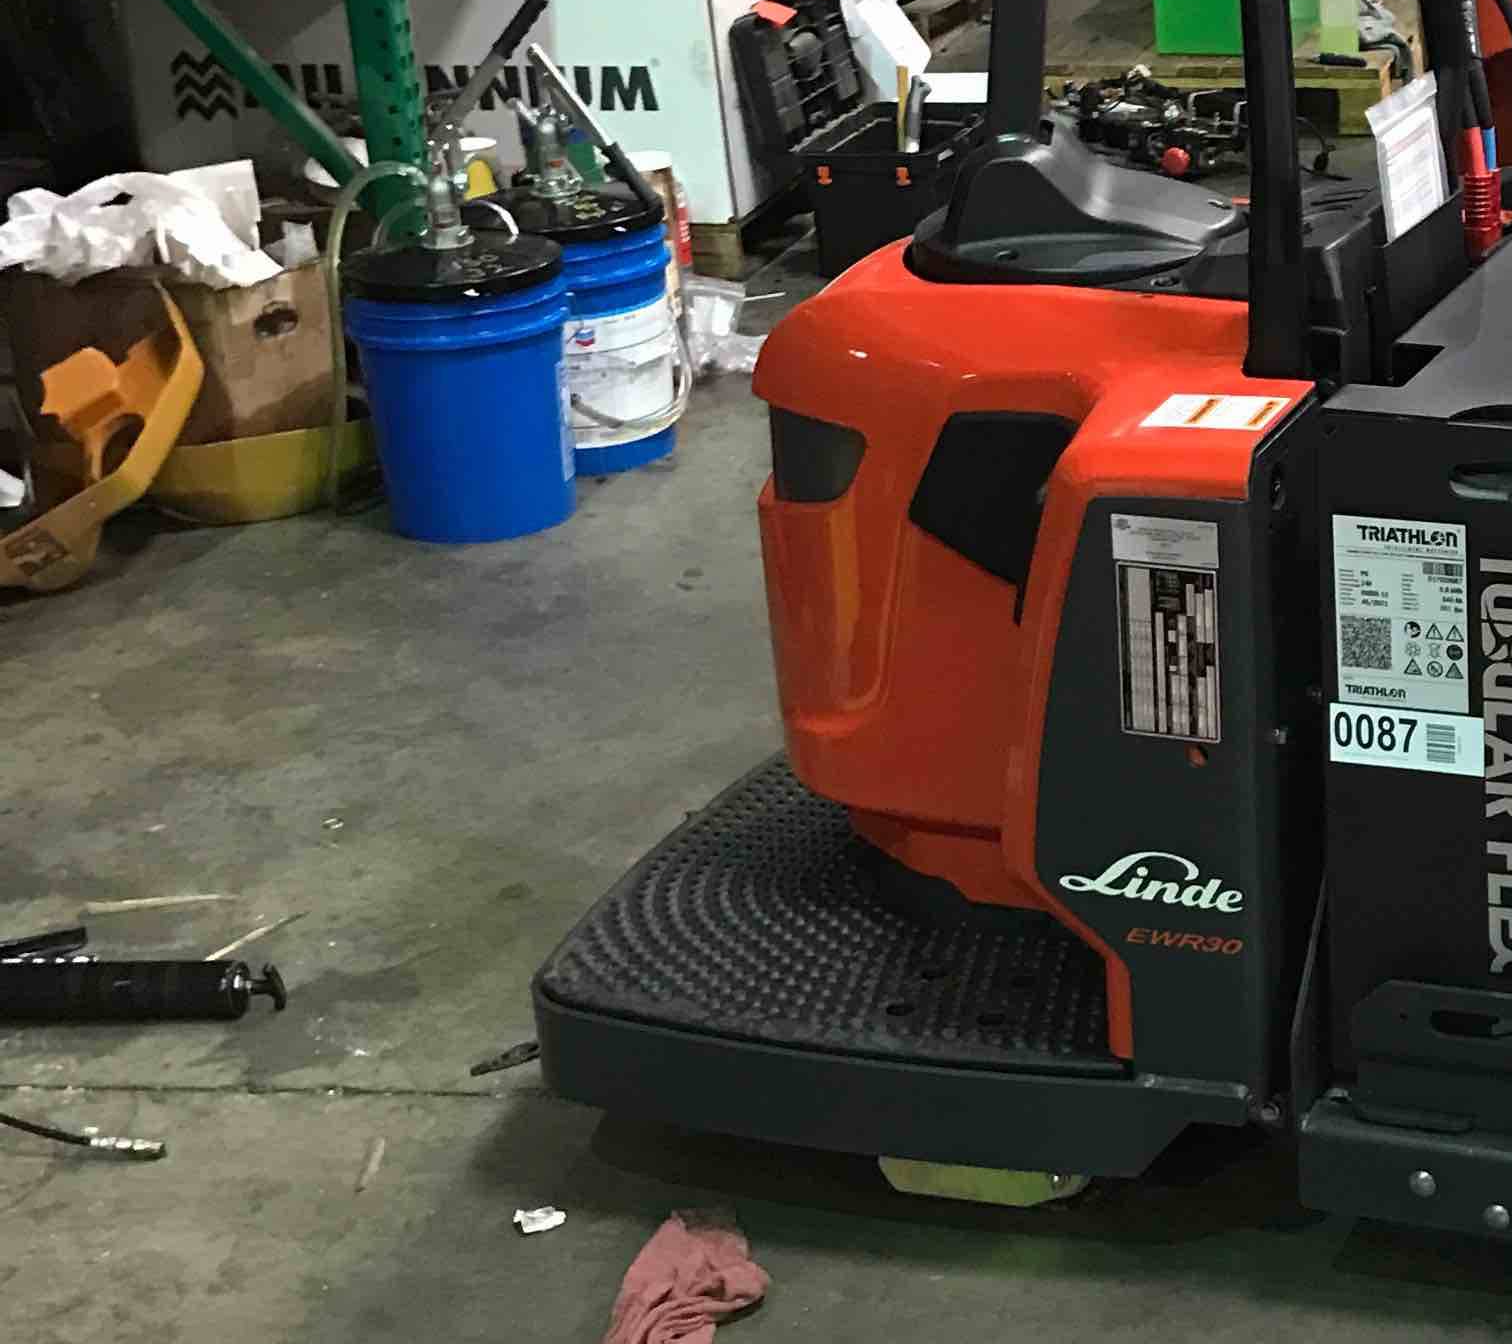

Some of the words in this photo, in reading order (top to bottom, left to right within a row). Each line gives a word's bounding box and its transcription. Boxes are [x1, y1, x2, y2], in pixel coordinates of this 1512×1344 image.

[1357, 524, 1458, 548] TRIATHLON
[1334, 711, 1418, 754] 0087
[1058, 850, 1244, 913] Linde
[1126, 926, 1244, 955] EWR30
